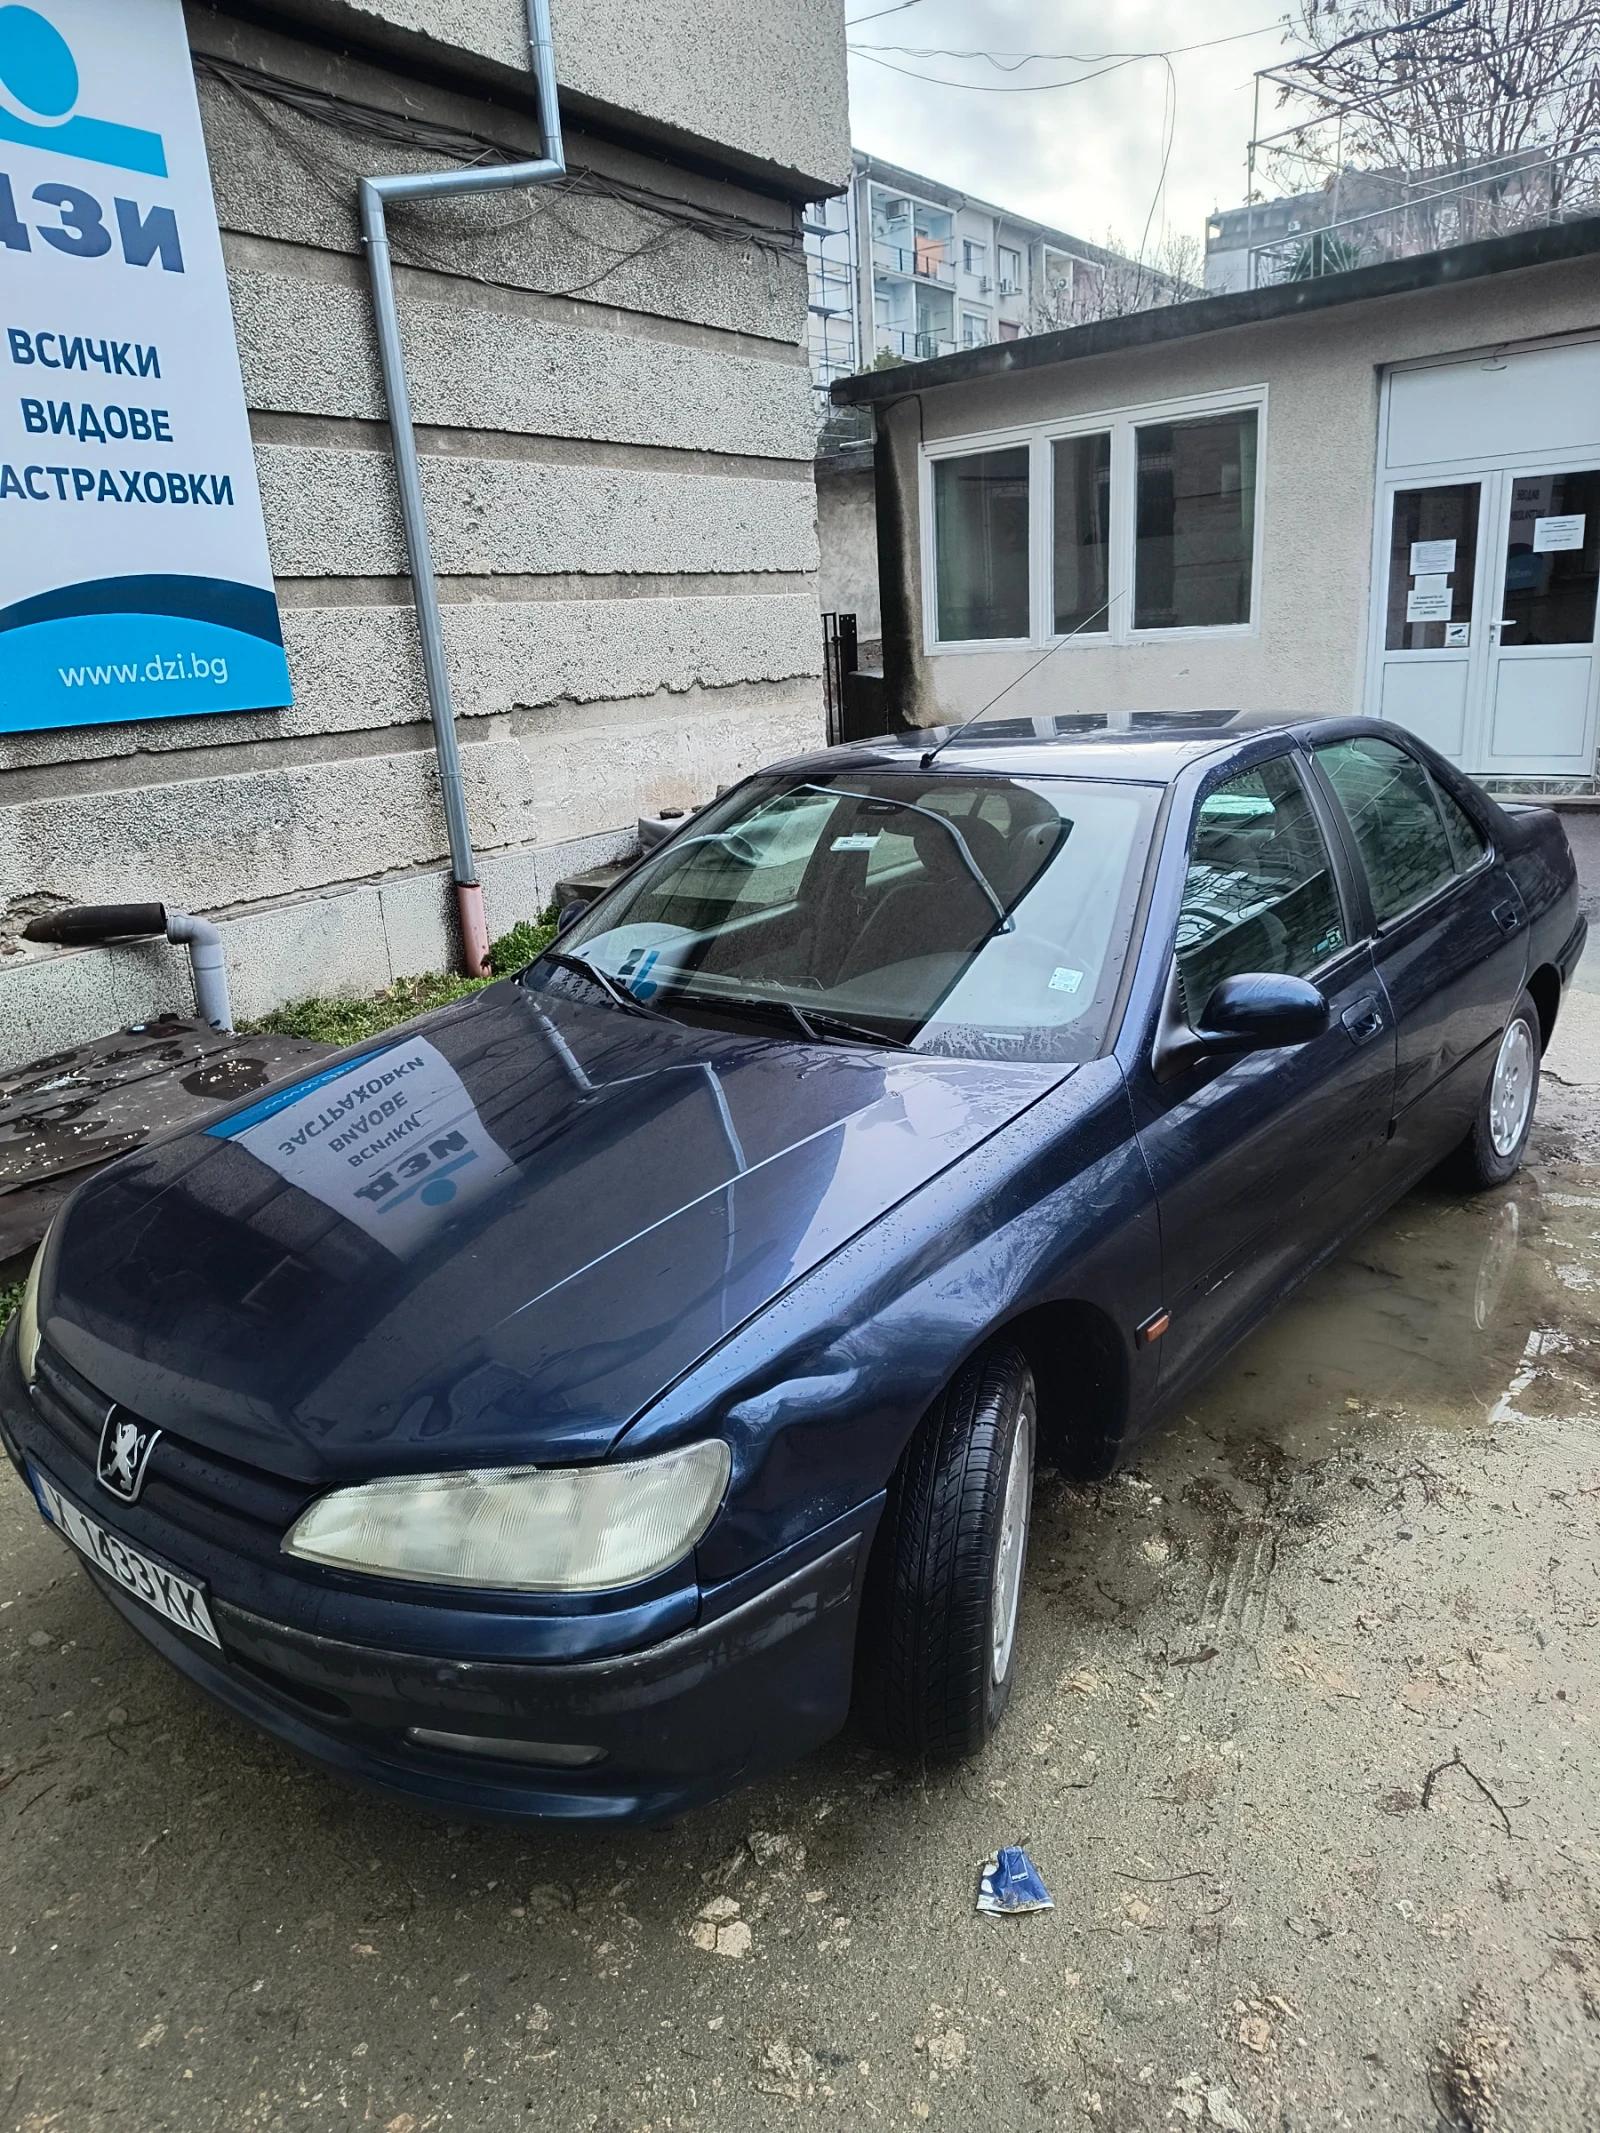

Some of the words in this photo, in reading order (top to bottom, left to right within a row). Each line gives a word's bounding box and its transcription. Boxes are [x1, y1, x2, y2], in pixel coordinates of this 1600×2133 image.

[7, 328, 161, 379] ВСИЧКИ
[20, 398, 174, 443] ВИДОВЕ
[0, 464, 234, 505] АСТРАХОВКИ
[58, 652, 228, 687] www.dzi.bg
